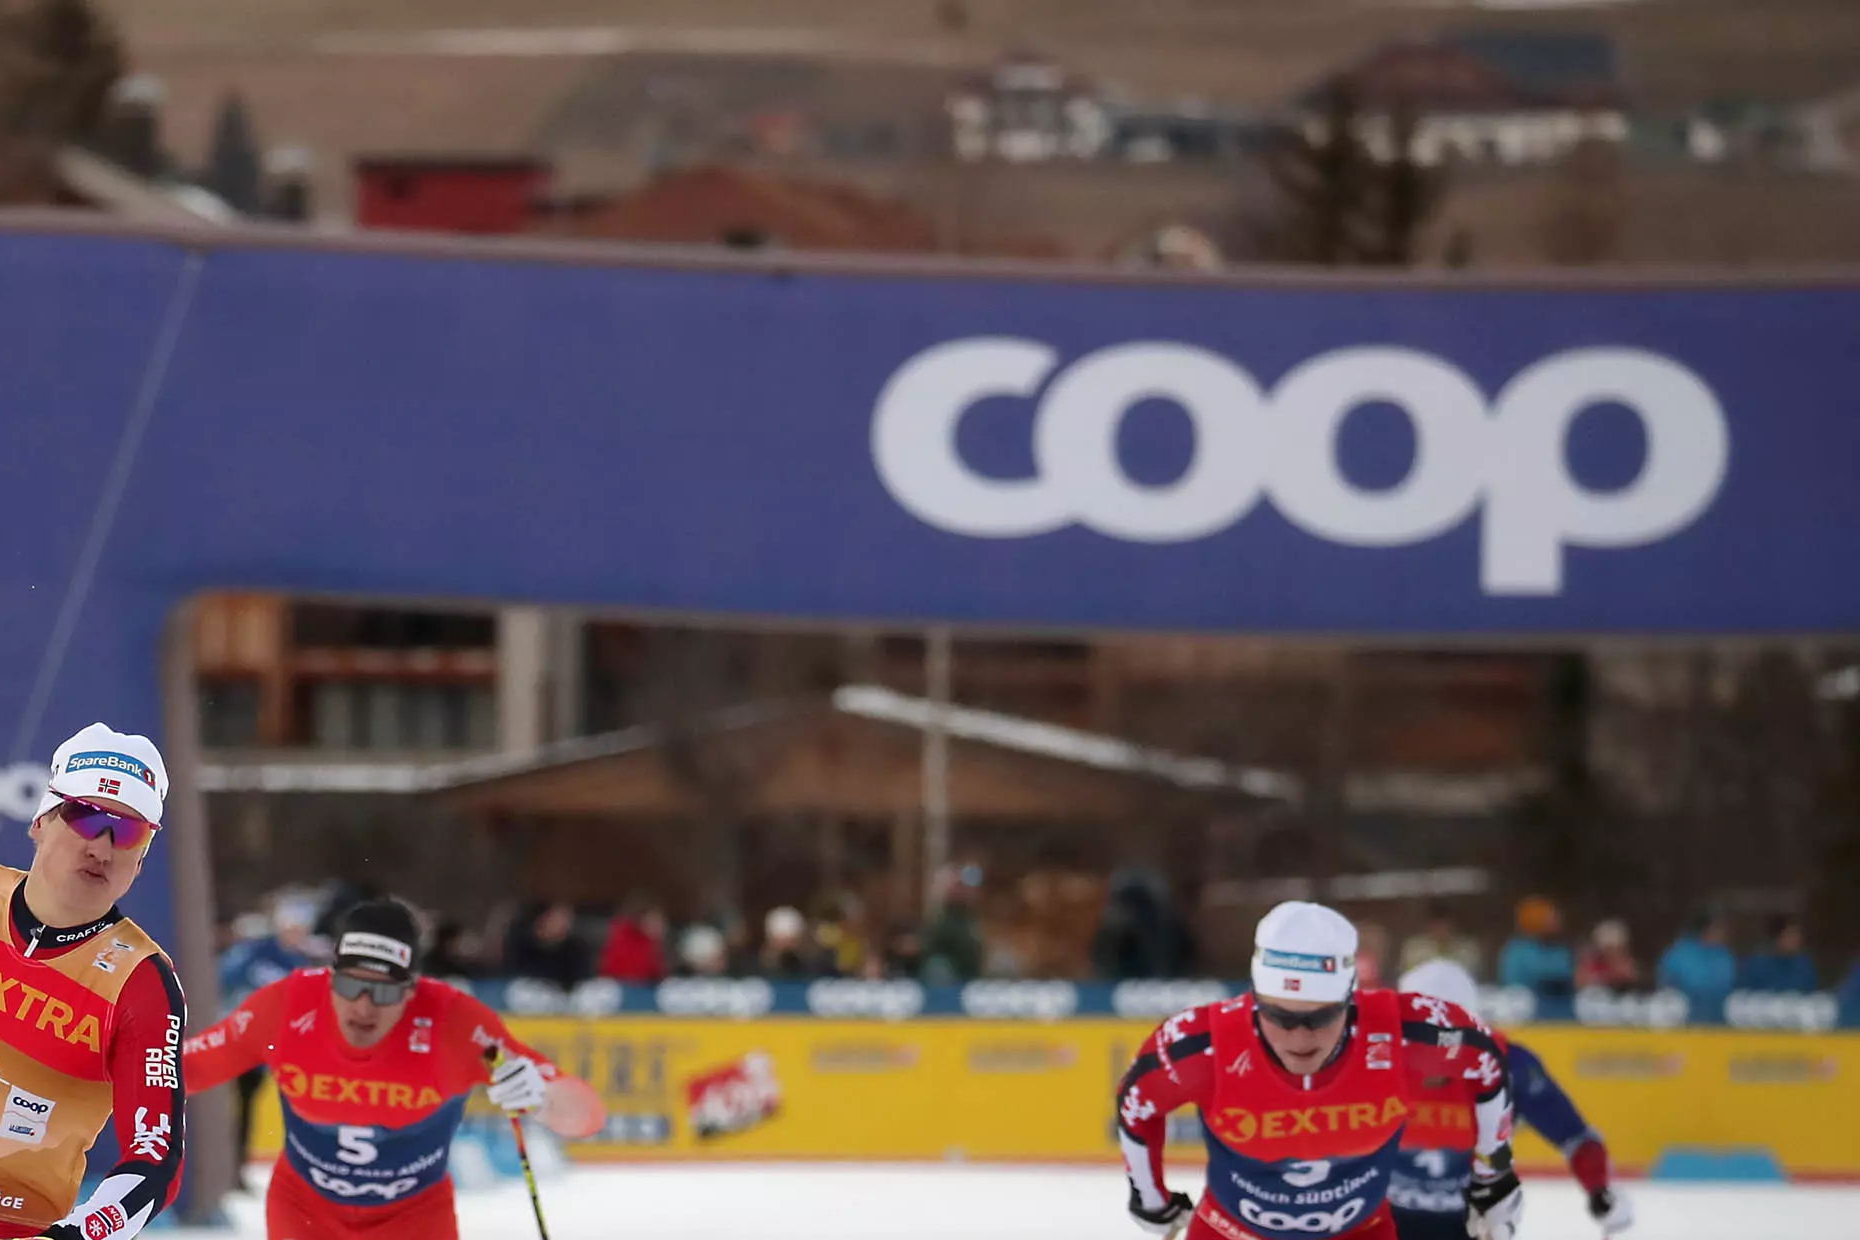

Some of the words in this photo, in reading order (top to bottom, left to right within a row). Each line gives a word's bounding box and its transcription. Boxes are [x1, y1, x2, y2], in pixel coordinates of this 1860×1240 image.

[870, 335, 1730, 596] coop
[68, 755, 142, 777] SpareBank
[56, 925, 99, 942] CRAFT
[145, 1048, 163, 1088] ADE
[162, 1014, 180, 1090] POWER
[12, 1095, 49, 1115] coop
[311, 1074, 442, 1111] EXTRA
[1261, 1097, 1408, 1140] EXTRA
[336, 1124, 379, 1166] 5
[1239, 1198, 1365, 1234] coop
